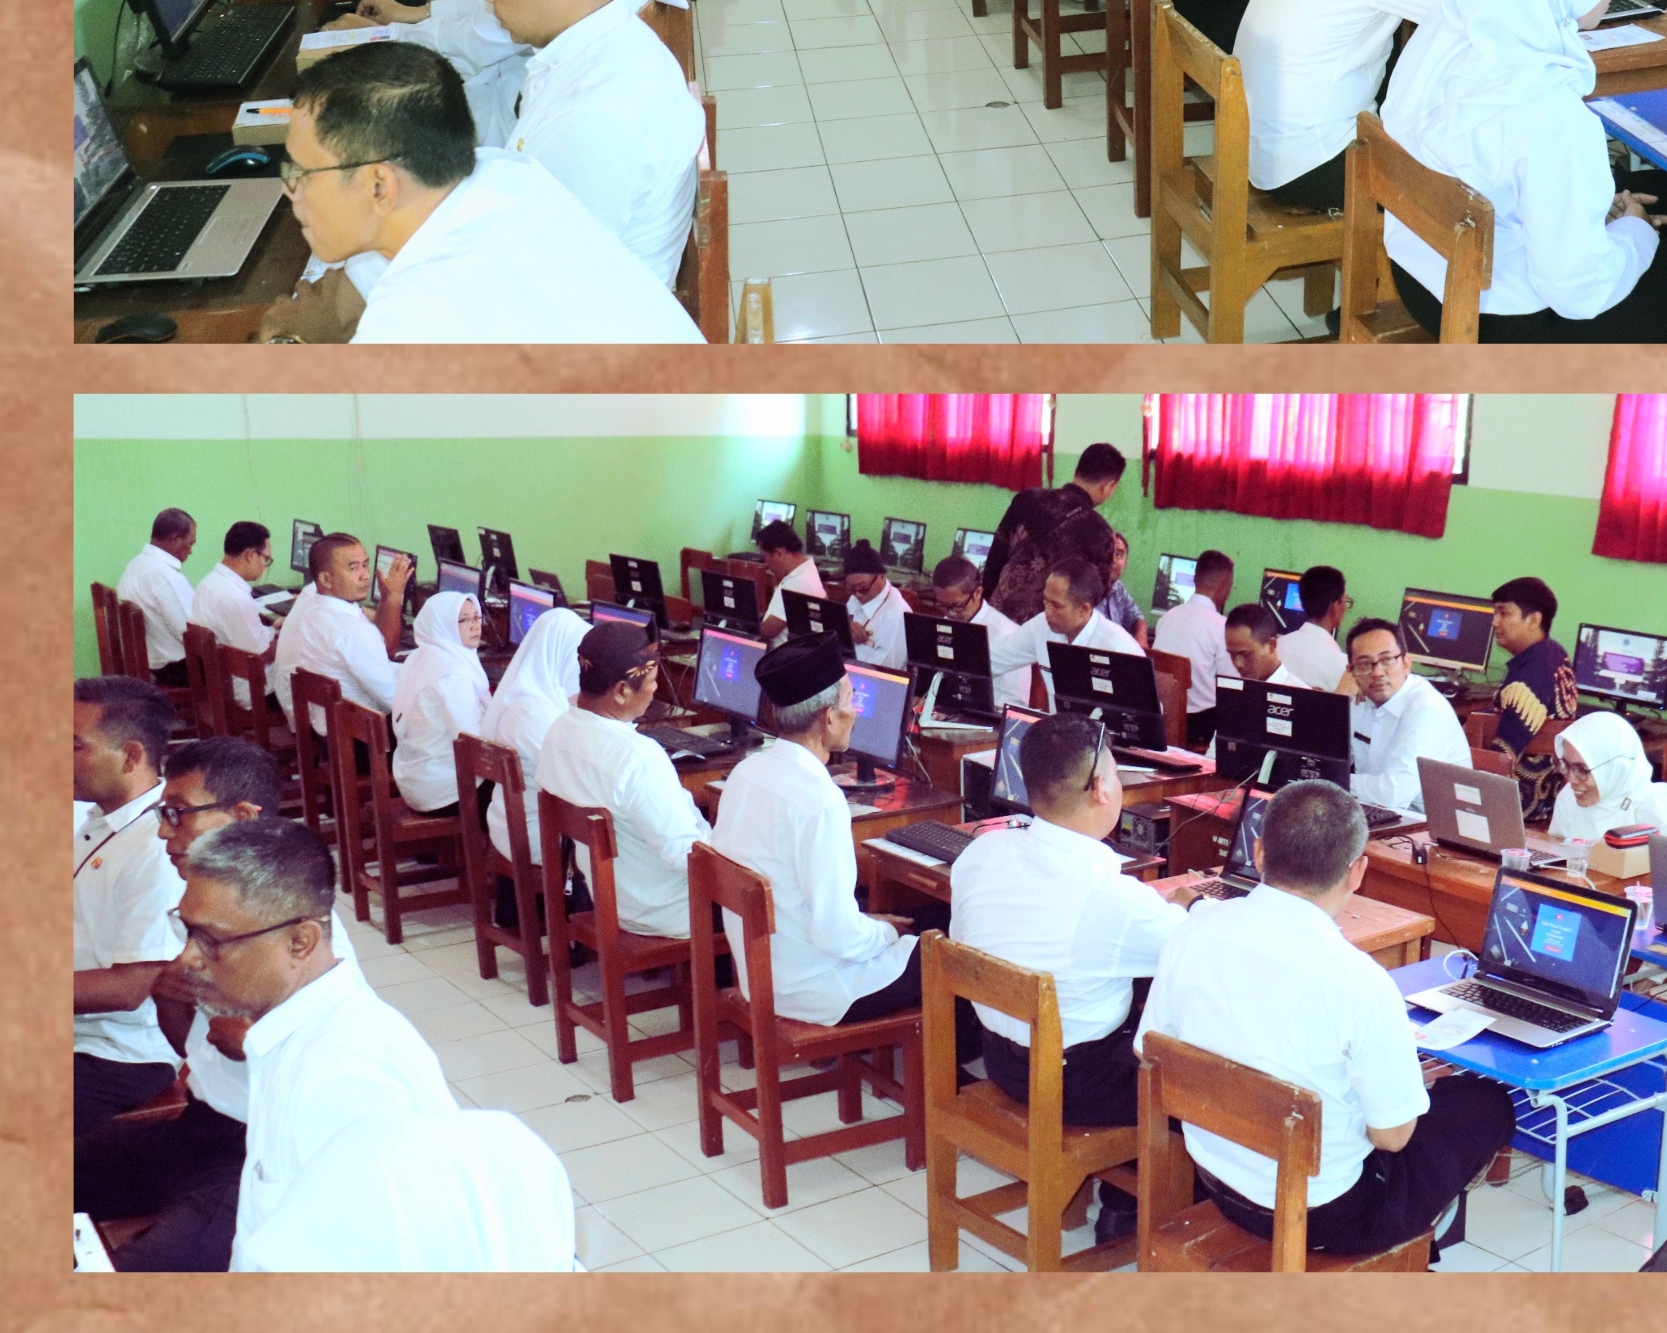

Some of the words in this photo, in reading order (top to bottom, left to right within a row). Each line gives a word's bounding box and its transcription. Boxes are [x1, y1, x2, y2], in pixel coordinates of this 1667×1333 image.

[936, 634, 954, 644] acer
[1090, 666, 1112, 678] acer
[1266, 704, 1295, 717] acer
